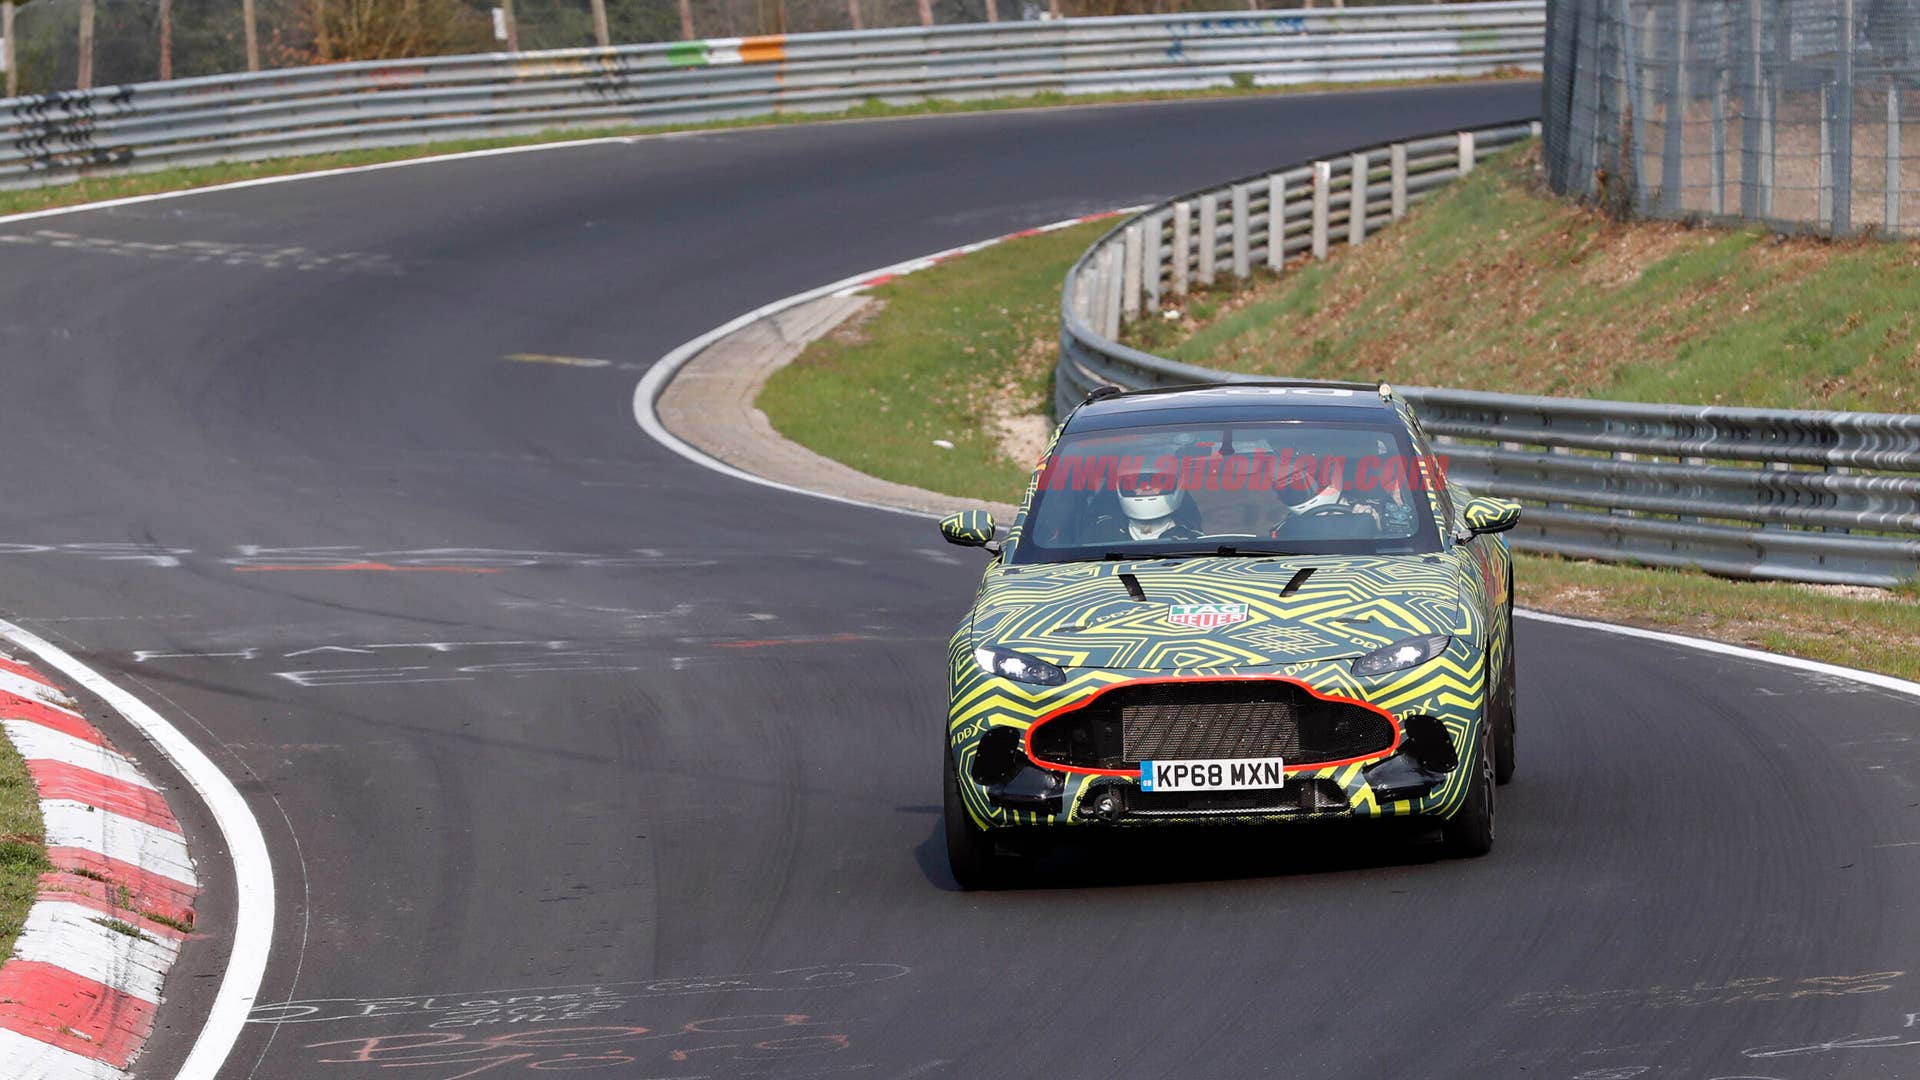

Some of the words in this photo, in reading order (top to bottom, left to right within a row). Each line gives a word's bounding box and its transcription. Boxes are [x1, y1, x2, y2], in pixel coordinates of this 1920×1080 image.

[1177, 605, 1241, 614] TAG
[1171, 613, 1244, 628] HEUER
[1157, 764, 1223, 787] KP68
[1231, 762, 1280, 786] MXN
